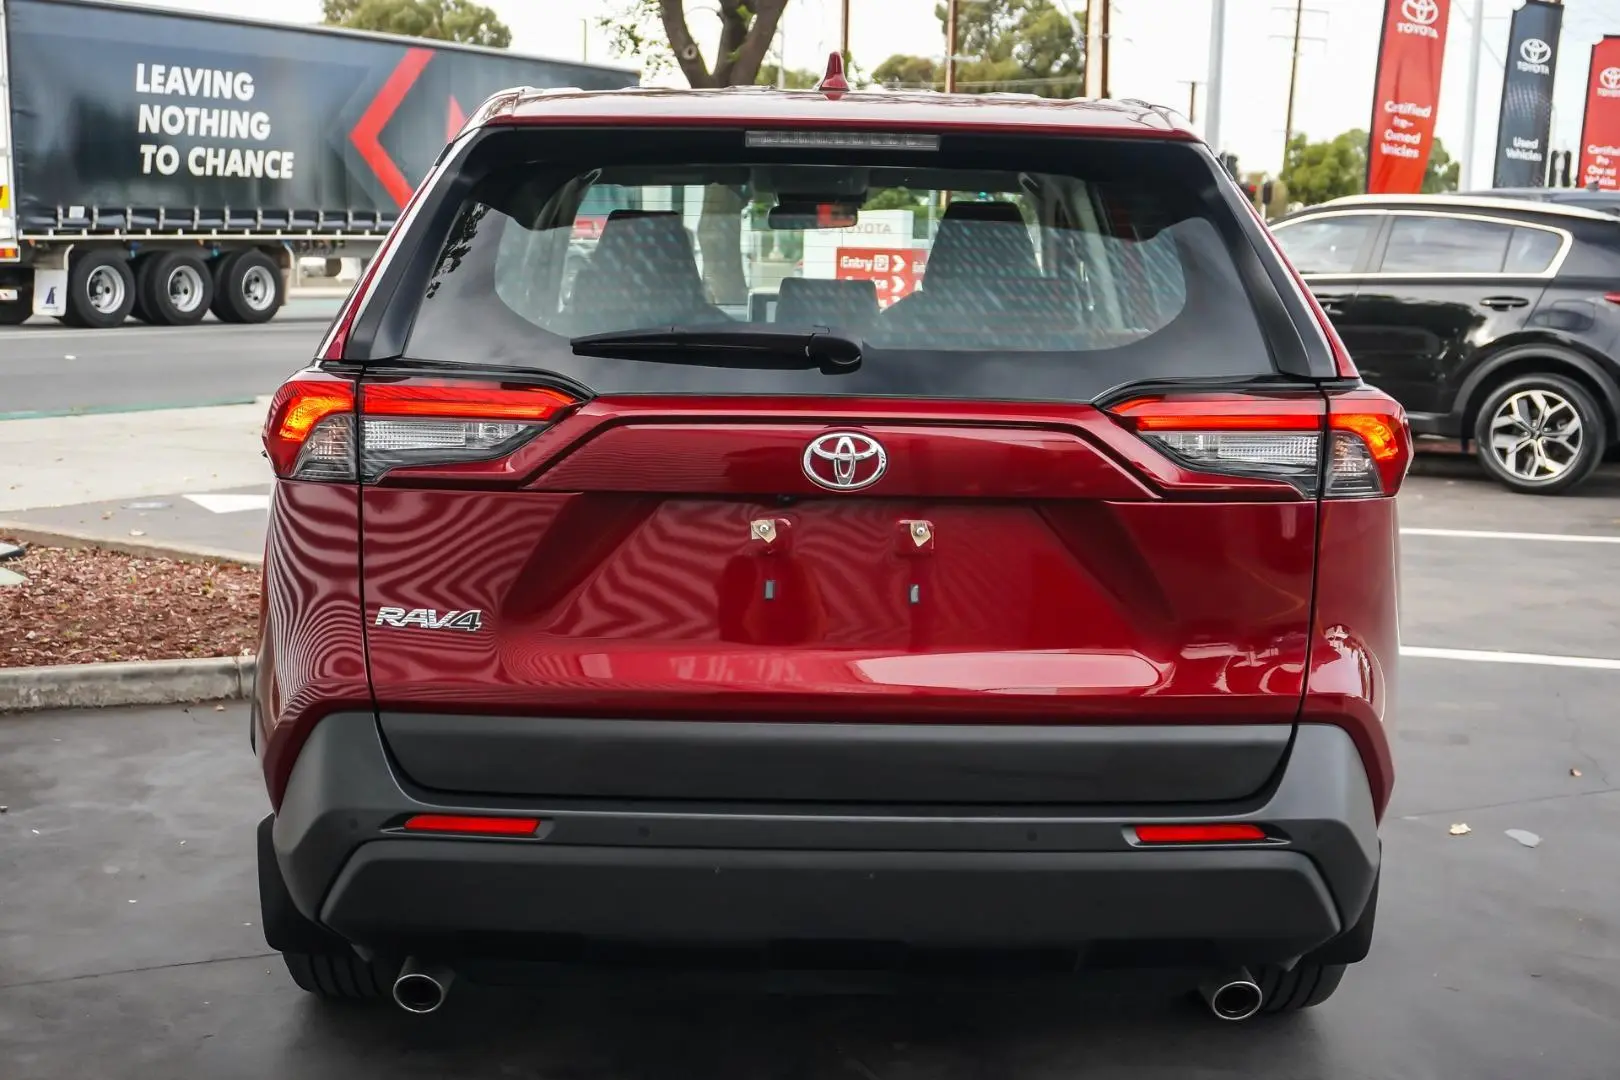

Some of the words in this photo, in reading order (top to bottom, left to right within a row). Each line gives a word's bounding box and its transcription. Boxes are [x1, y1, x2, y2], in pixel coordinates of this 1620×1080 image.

[1396, 22, 1439, 39] TOYOTA
[1516, 61, 1550, 75] TOYOTA
[136, 63, 255, 101] LEAVING
[138, 104, 271, 140] NOTHING
[1512, 136, 1539, 149] Used
[140, 144, 180, 175] TO
[188, 147, 294, 179] CHANCE
[1505, 147, 1542, 161] Vehicles
[841, 256, 874, 273] Entry
[374, 606, 483, 632] RAV4
